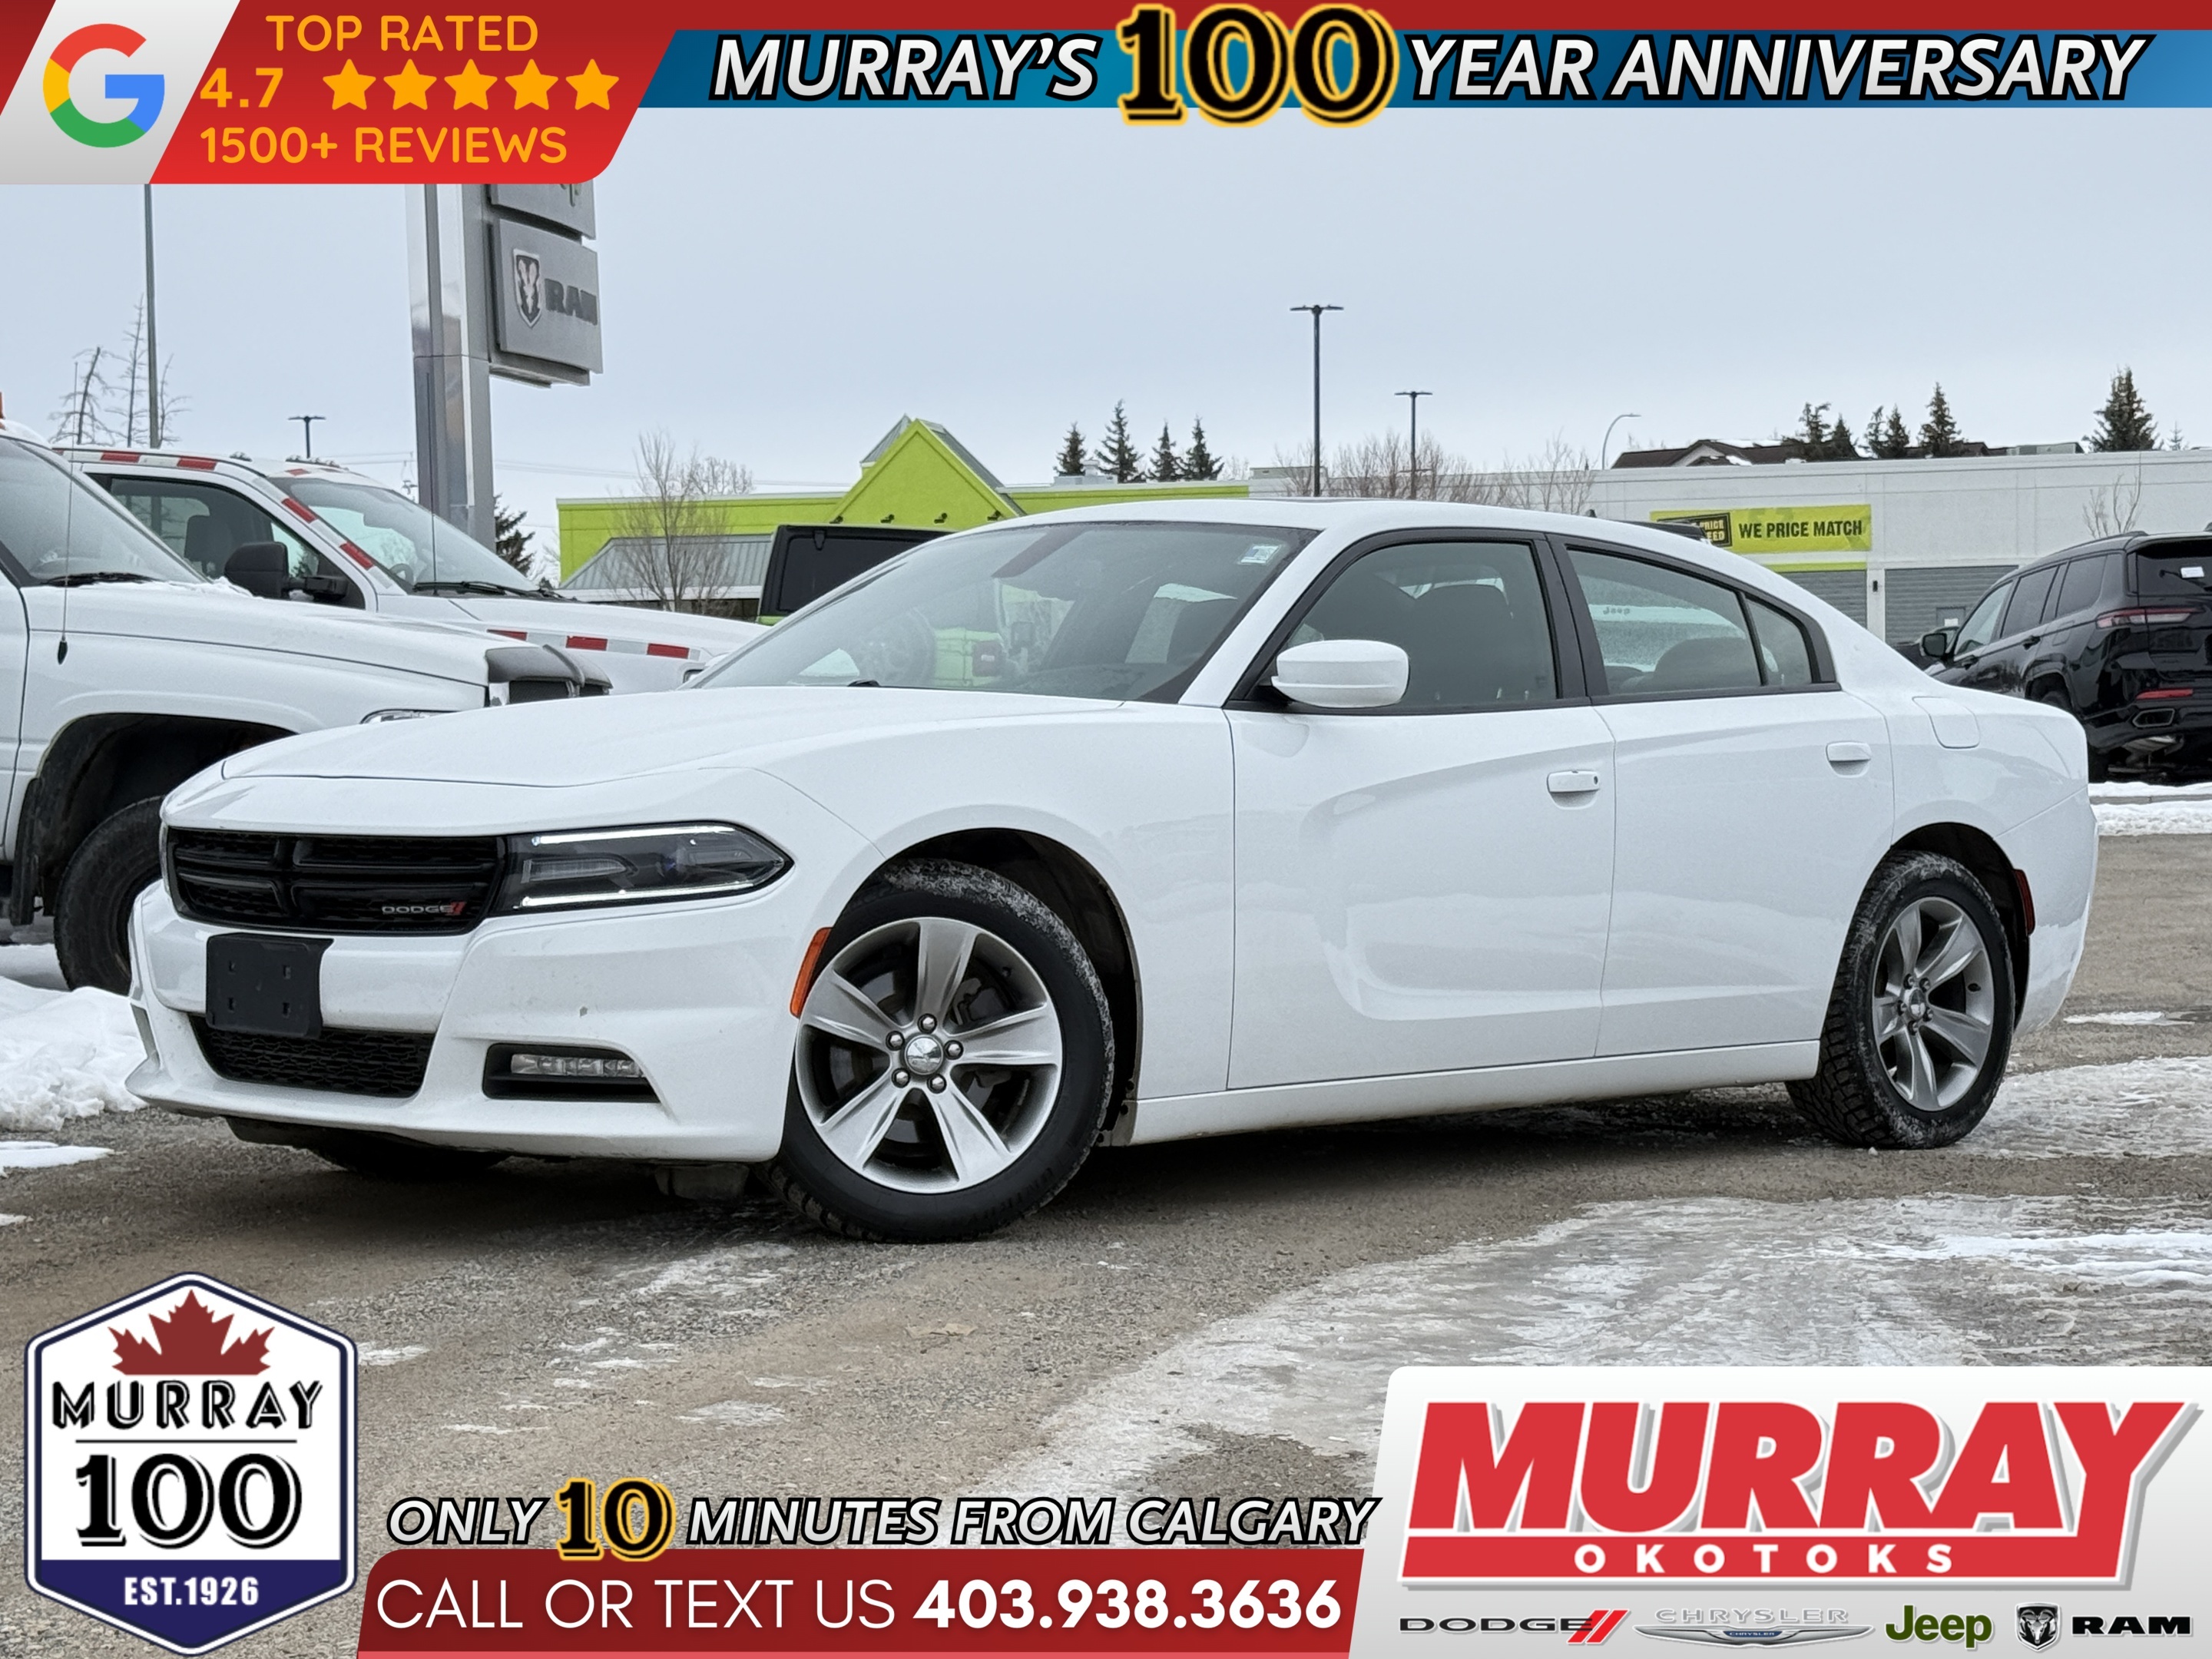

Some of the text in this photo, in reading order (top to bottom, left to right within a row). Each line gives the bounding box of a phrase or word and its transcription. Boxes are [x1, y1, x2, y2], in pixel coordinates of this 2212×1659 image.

[1739, 522, 1762, 539] WE
[1767, 522, 1809, 538] PRICE
[1813, 520, 1862, 537] MATCH
[382, 906, 453, 914] DODGE
